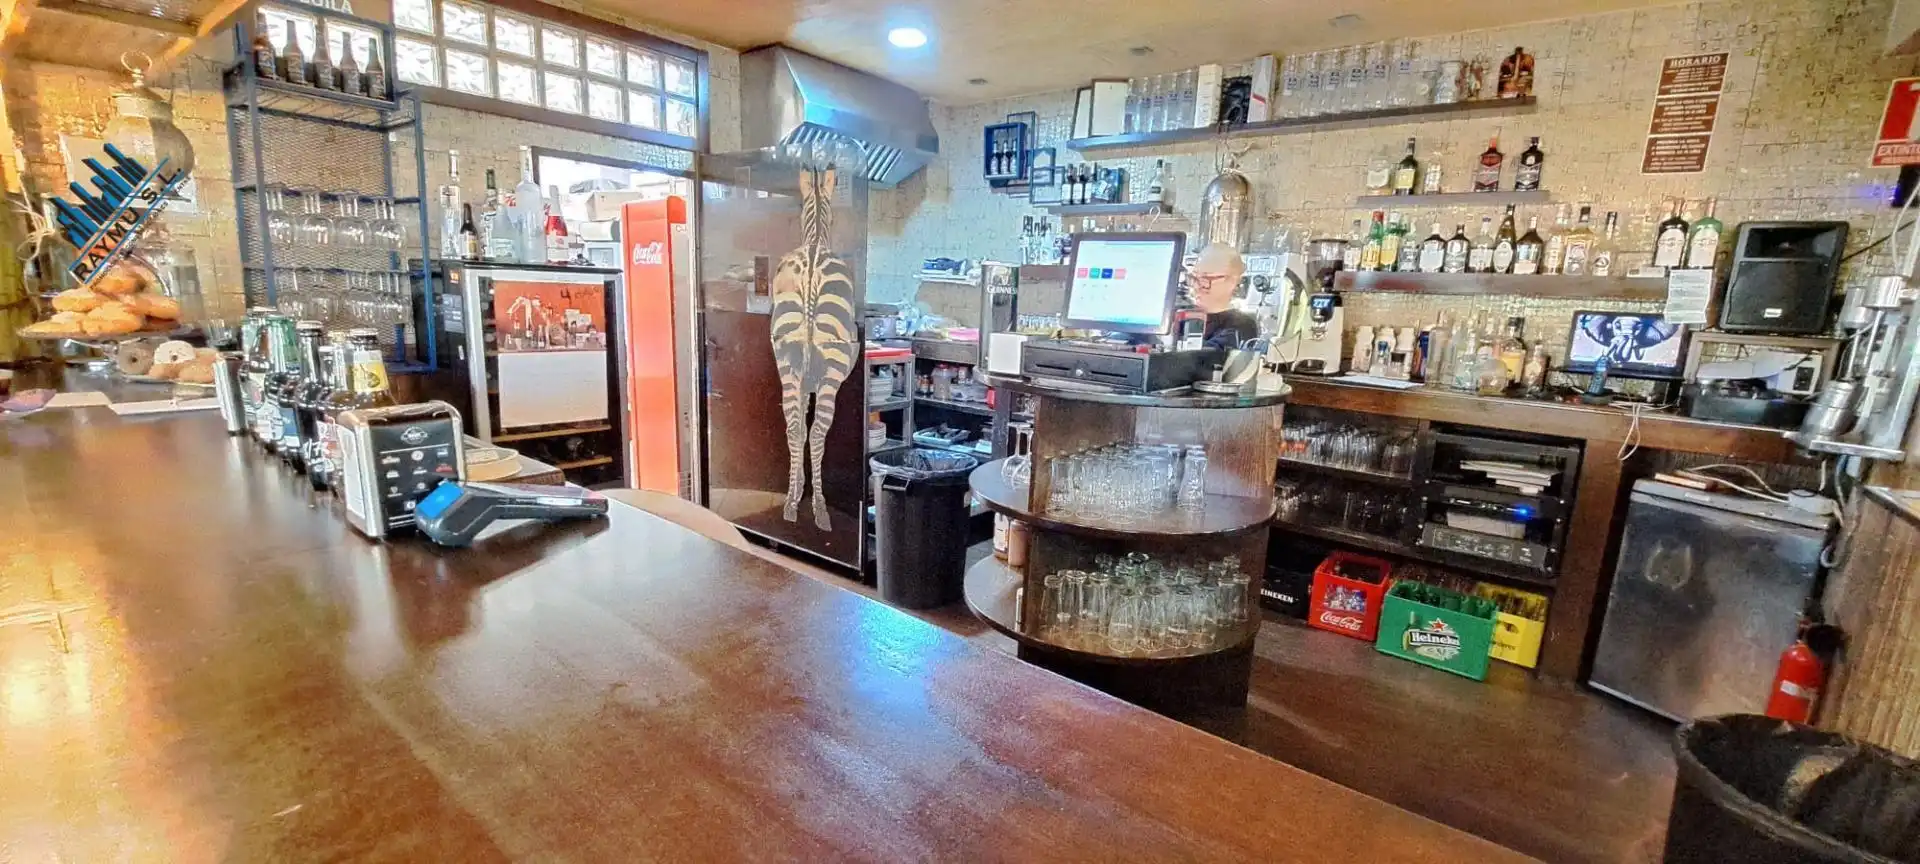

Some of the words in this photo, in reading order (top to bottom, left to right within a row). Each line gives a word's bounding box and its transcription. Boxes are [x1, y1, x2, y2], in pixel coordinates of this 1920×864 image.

[1670, 55, 1721, 69] HORARIO
[987, 284, 1017, 295] GUINNES
[1260, 588, 1293, 603] EINEKEN
